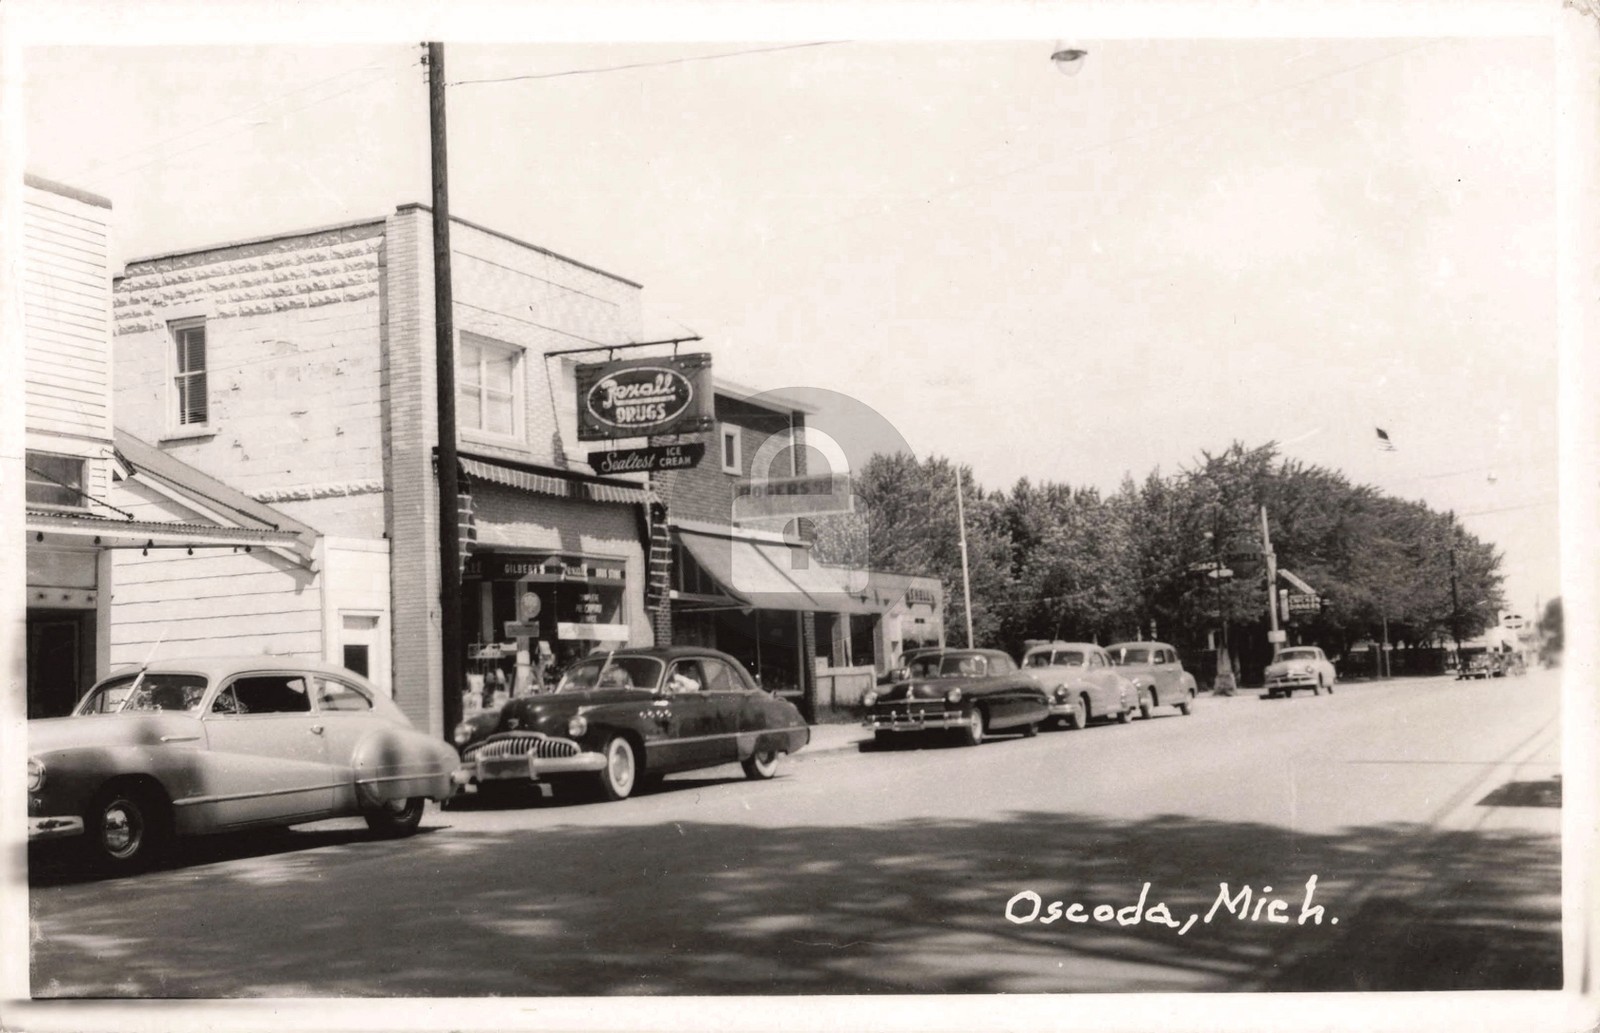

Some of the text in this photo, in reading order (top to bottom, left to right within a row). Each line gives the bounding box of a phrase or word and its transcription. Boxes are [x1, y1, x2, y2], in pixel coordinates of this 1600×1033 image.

[601, 374, 676, 409] Rexall
[615, 403, 666, 423] DRUGS
[659, 455, 691, 467] CREAM
[666, 447, 682, 456] ICE
[601, 452, 656, 472] Sealtest
